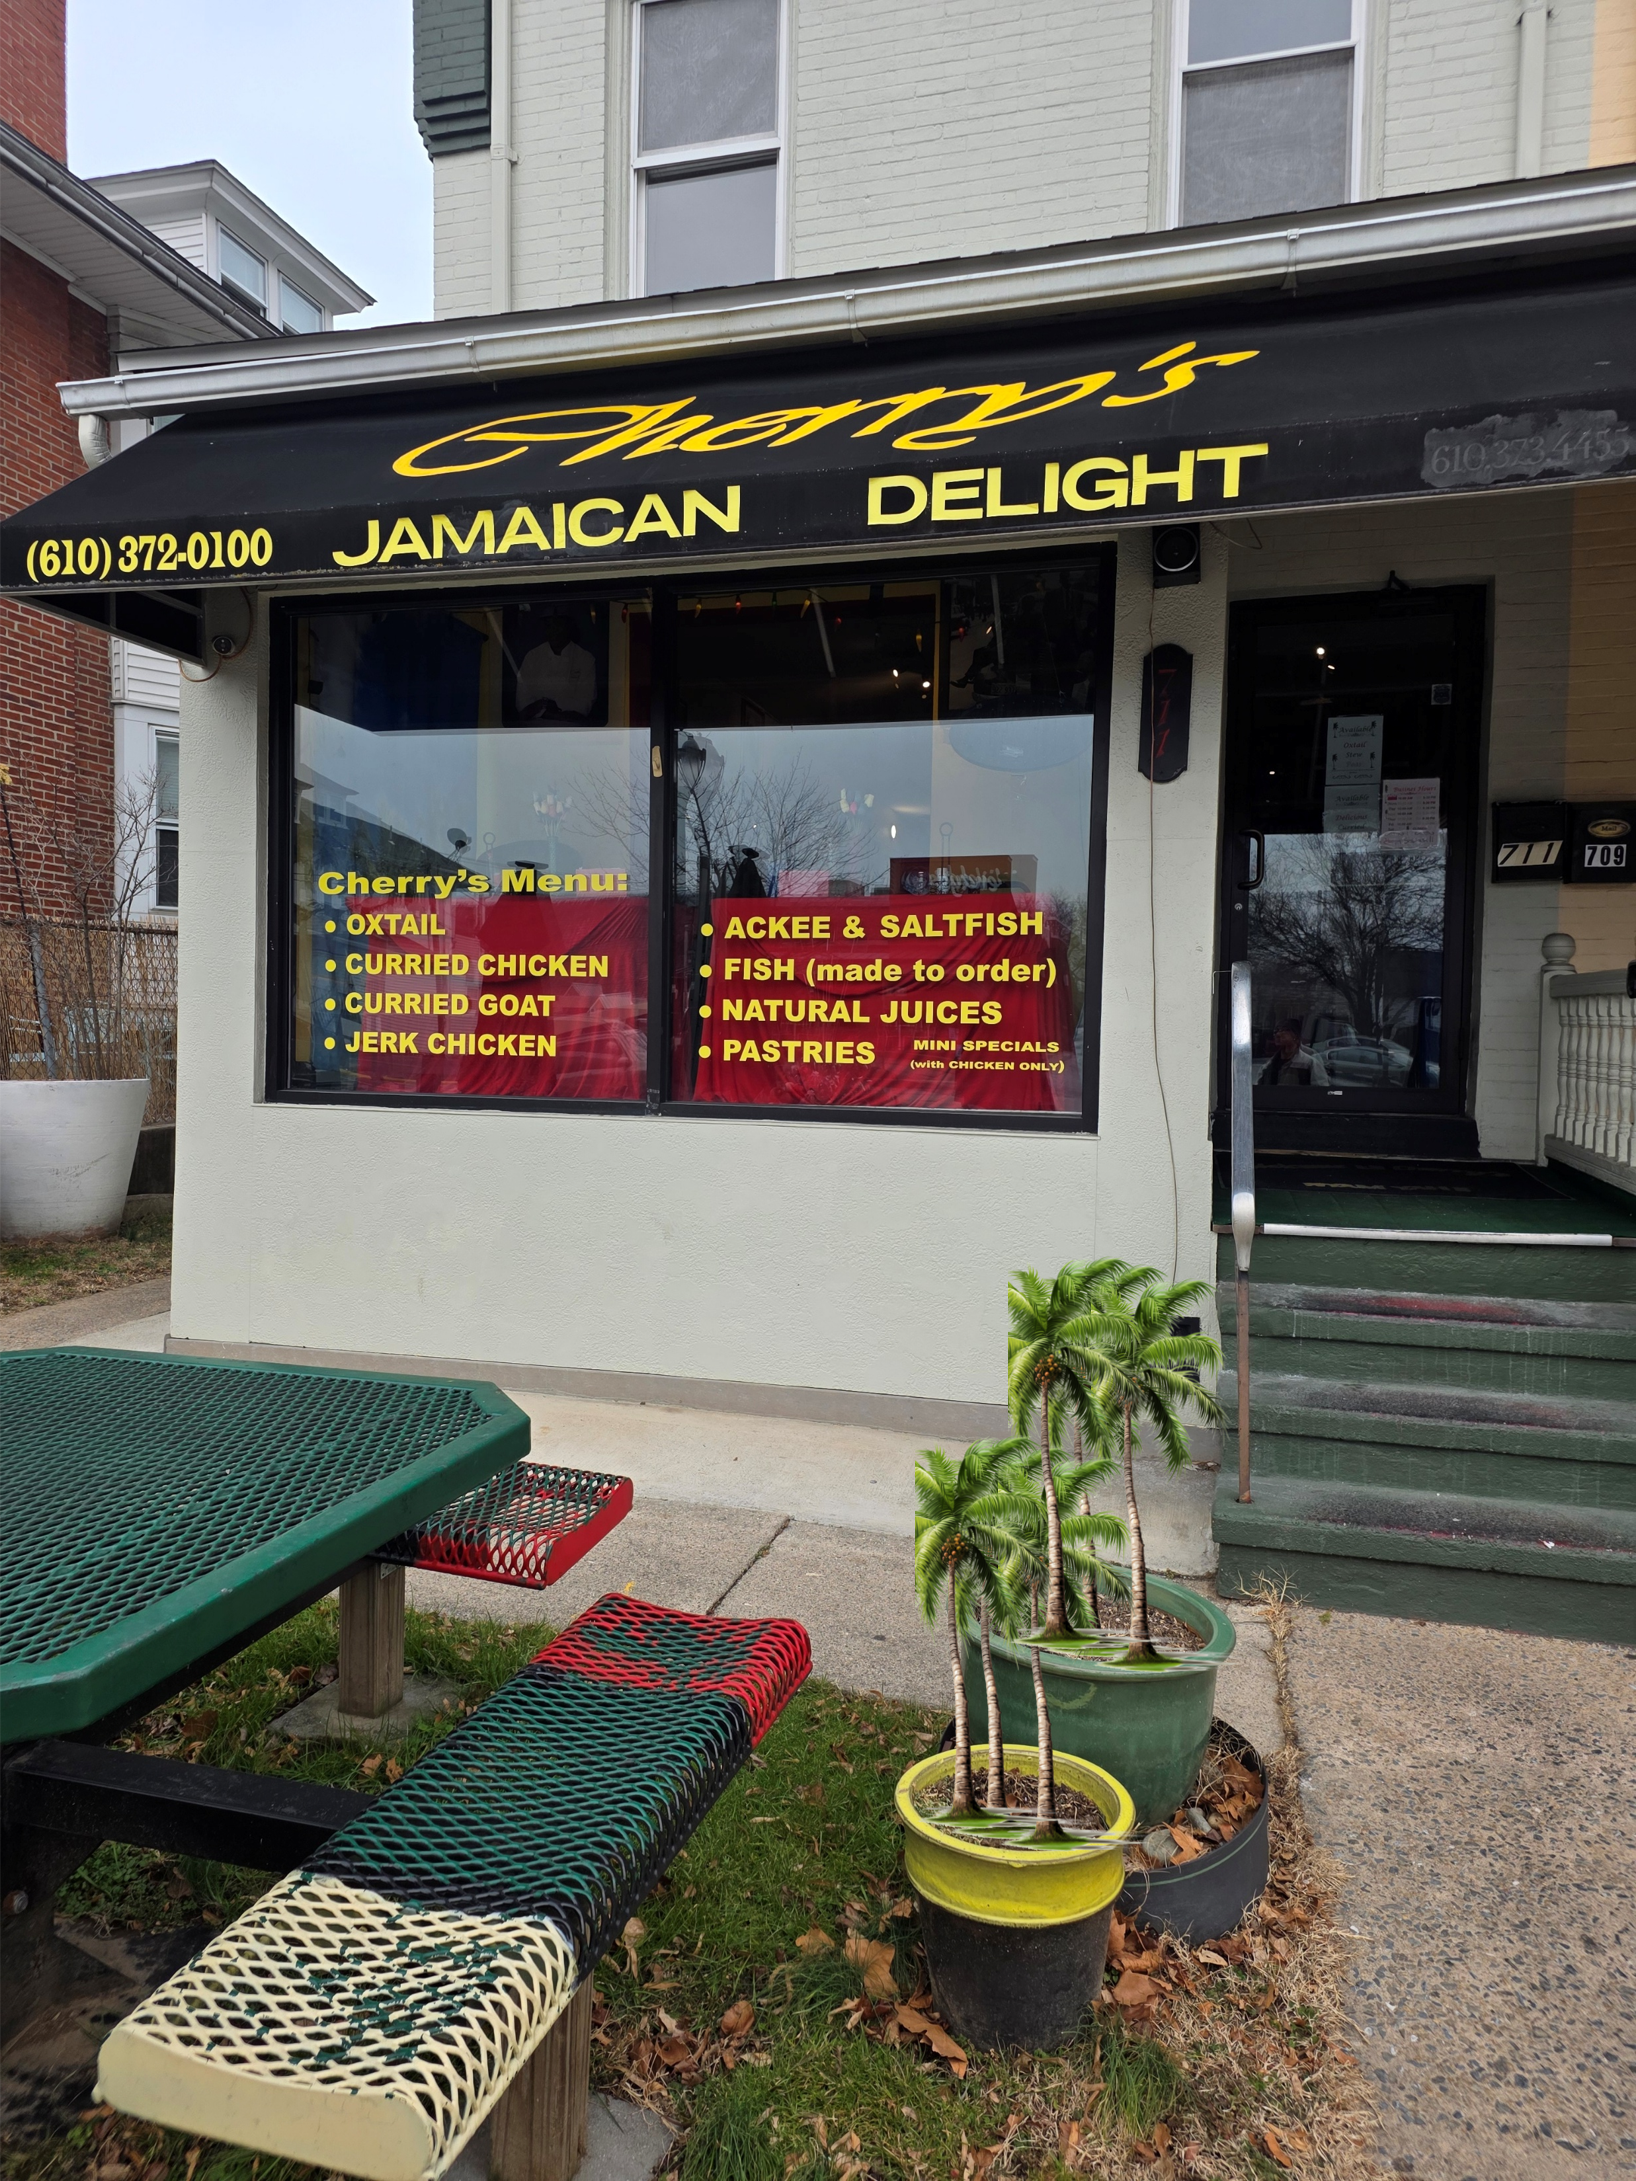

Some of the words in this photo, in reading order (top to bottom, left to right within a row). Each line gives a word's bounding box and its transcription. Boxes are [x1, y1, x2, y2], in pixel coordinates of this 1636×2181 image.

[392, 341, 1260, 478] Cherry's
[332, 484, 742, 567] JAMAICAN
[867, 443, 1269, 526] DELIGHT
[26, 537, 112, 581] (610)
[118, 527, 274, 573] 372-0100
[1343, 741, 1367, 749] Oxtail
[1499, 842, 1555, 865] 711
[1586, 845, 1625, 866] 709
[318, 869, 490, 900] Cherry's
[501, 868, 629, 893] Menu:
[346, 913, 446, 936] OXTAIL
[722, 916, 831, 939] ACKEE
[842, 915, 865, 939] &
[880, 911, 1043, 938] SALTFISH
[345, 953, 470, 976] CURRIED
[477, 953, 609, 978] CHICKEN
[724, 958, 795, 981] FISH
[805, 958, 902, 987] (made
[912, 959, 945, 982] to
[956, 958, 1057, 988] order)
[345, 992, 470, 1015] CURRIED
[478, 993, 556, 1017] GOAT
[722, 999, 870, 1023] NATURAL
[880, 1000, 1002, 1025] JUICES
[345, 1031, 419, 1054] JERK
[427, 1032, 557, 1057] CHICKEN
[723, 1039, 876, 1065] PASTRIES
[913, 1039, 956, 1051] MINI
[962, 1040, 1060, 1053] SPECIALS
[910, 1059, 945, 1070] (with
[948, 1060, 1015, 1070] CHICKEN
[1019, 1060, 1065, 1074] ONLY)
